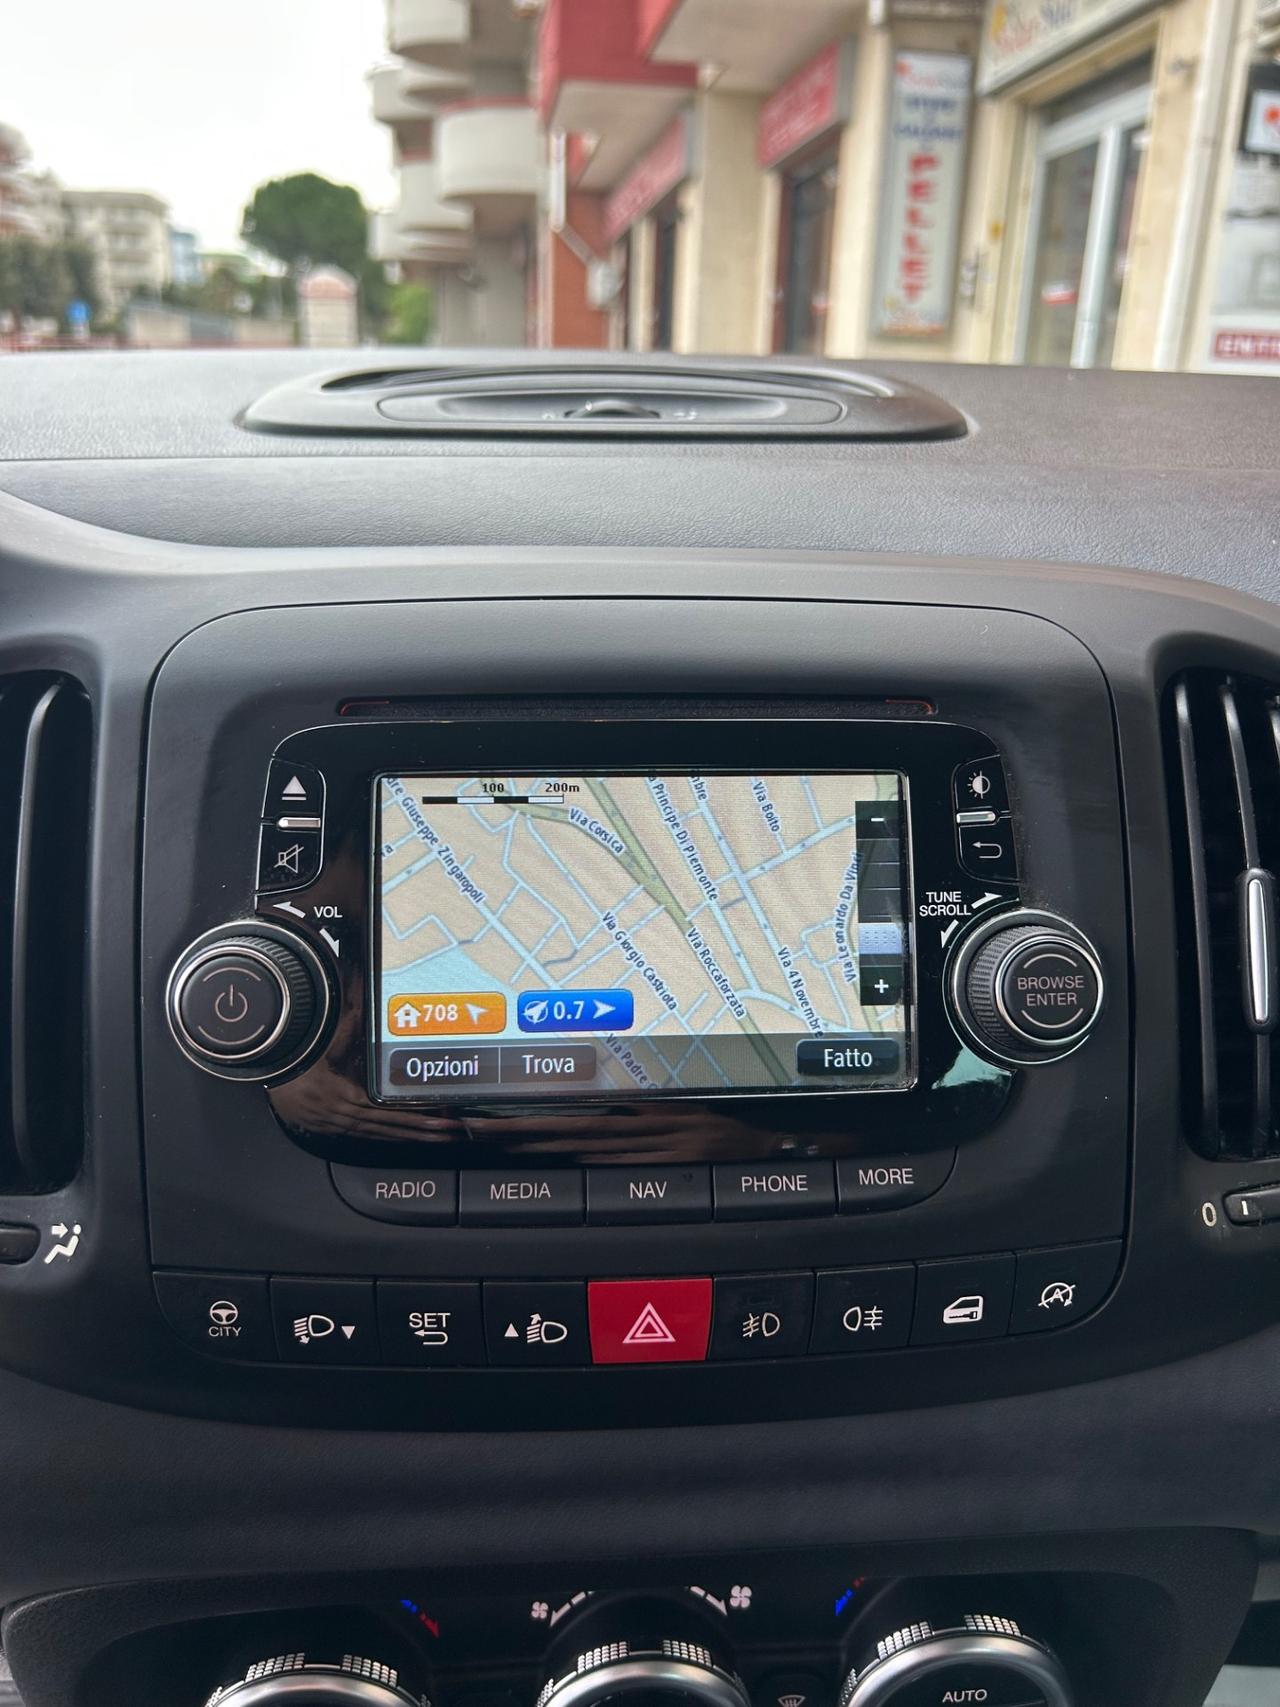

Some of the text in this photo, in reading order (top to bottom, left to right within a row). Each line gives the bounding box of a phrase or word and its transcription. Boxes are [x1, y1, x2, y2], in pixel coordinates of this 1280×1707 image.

[482, 782, 504, 793] 100
[545, 782, 580, 793] 200m
[753, 781, 780, 831] Via Boito
[570, 808, 624, 853] Via Corsica
[402, 796, 439, 846] Giuseppe
[438, 846, 485, 903] Zingaropoli
[653, 783, 718, 900] Principe Di Piemonte
[840, 885, 853, 900] Da
[926, 891, 962, 903] TUNE
[314, 906, 343, 918] VOL
[919, 903, 971, 916] SCROLL
[603, 912, 677, 1010] Via Giorgio Castriota
[688, 928, 745, 1017] Via Roccaforzata
[844, 961, 857, 982] Via
[778, 947, 824, 1038] Via 4 Novembre
[1017, 976, 1084, 991] BROWSE
[1026, 992, 1078, 1007] ENTER
[423, 1004, 459, 1022] 708
[553, 1001, 585, 1020] 0.7
[522, 1054, 575, 1074] Trova
[606, 1033, 648, 1083] Via Padre
[823, 1048, 873, 1068] Fatto
[406, 1055, 479, 1082] Opzioni
[741, 1175, 808, 1192] PHONE
[858, 1168, 914, 1185] MORE
[375, 1180, 436, 1199] RADIO
[490, 1182, 552, 1200] MEDIA
[629, 1181, 668, 1199] NAV
[1201, 1202, 1217, 1227] 0
[408, 1312, 451, 1328] SET
[208, 1326, 242, 1338] CITY
[942, 1688, 988, 1704] AUTO
